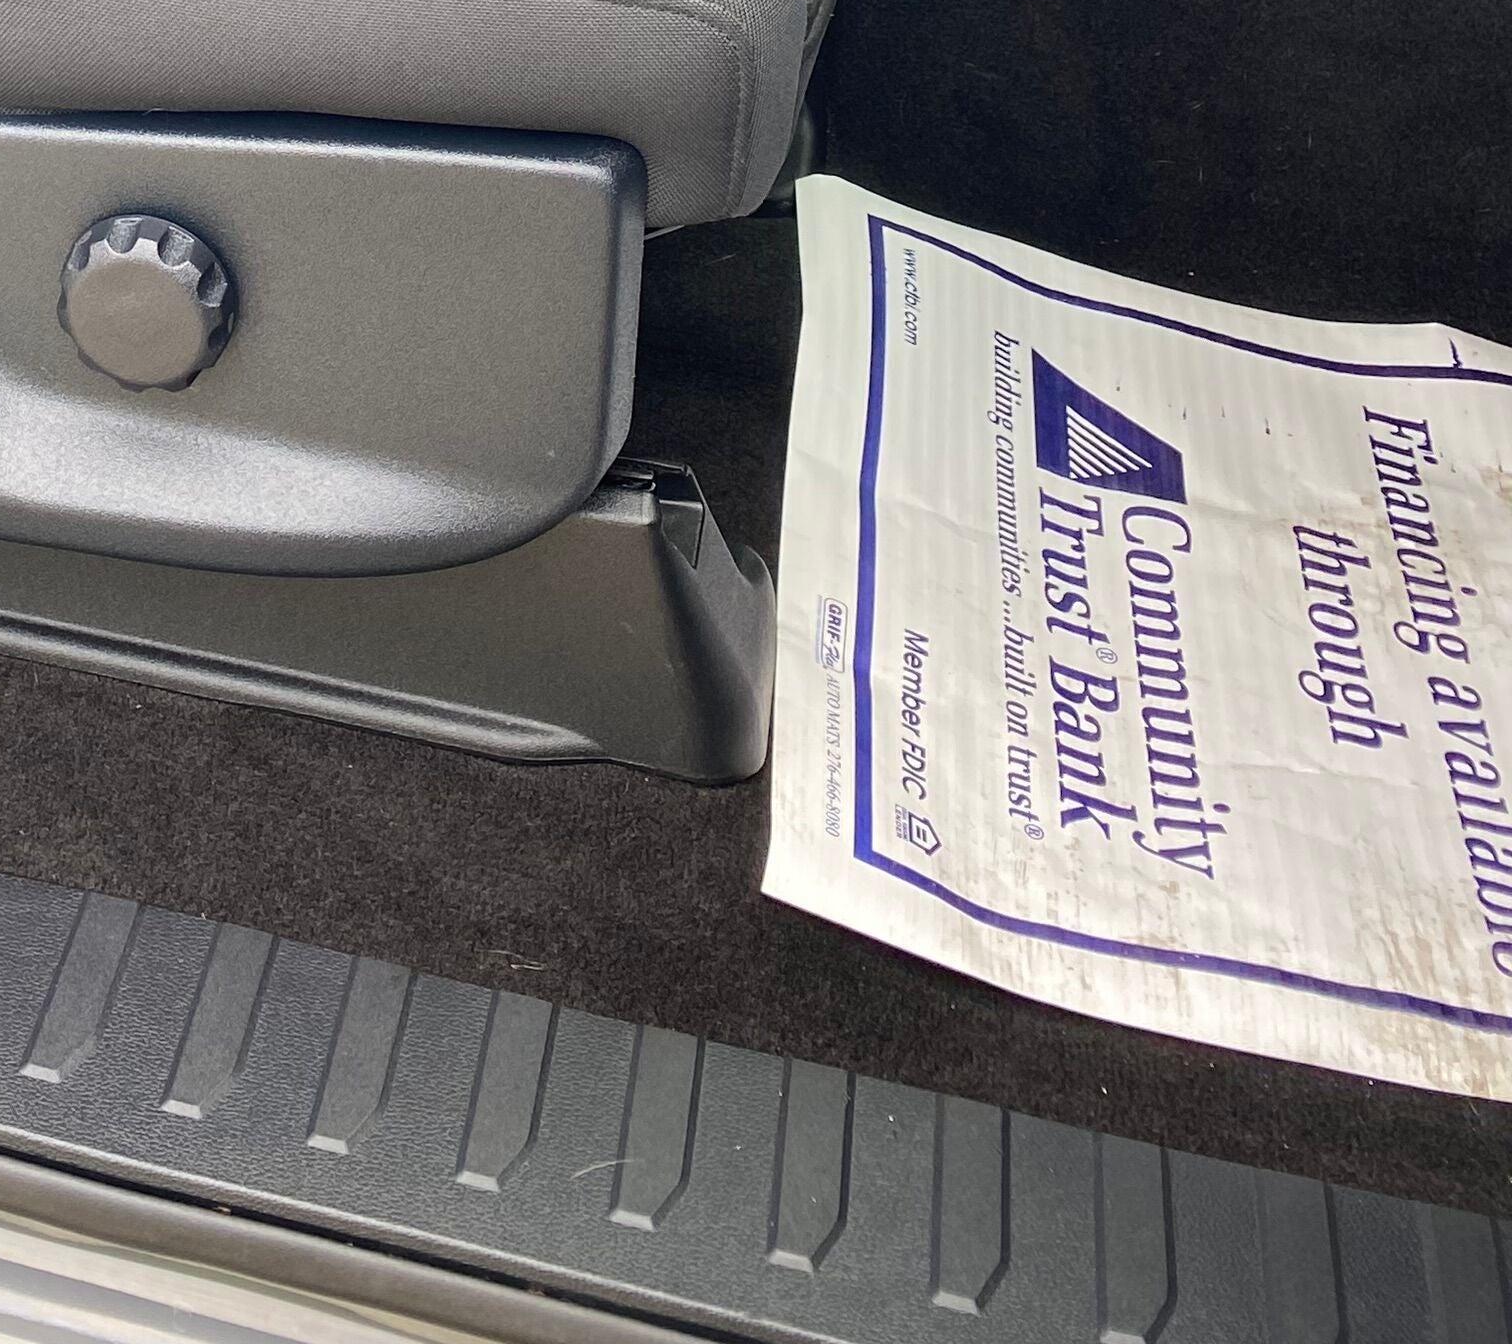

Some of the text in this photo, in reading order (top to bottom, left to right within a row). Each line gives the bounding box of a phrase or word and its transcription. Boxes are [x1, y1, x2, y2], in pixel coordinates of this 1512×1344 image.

[987, 330, 1021, 432] building
[996, 435, 1030, 599] communities
[1363, 405, 1473, 664] Financing
[901, 628, 929, 800] Member FDIC
[1005, 700, 1029, 736] on
[1120, 504, 1232, 879] Community
[1292, 524, 1409, 751] through
[1048, 655, 1138, 840] Bank
